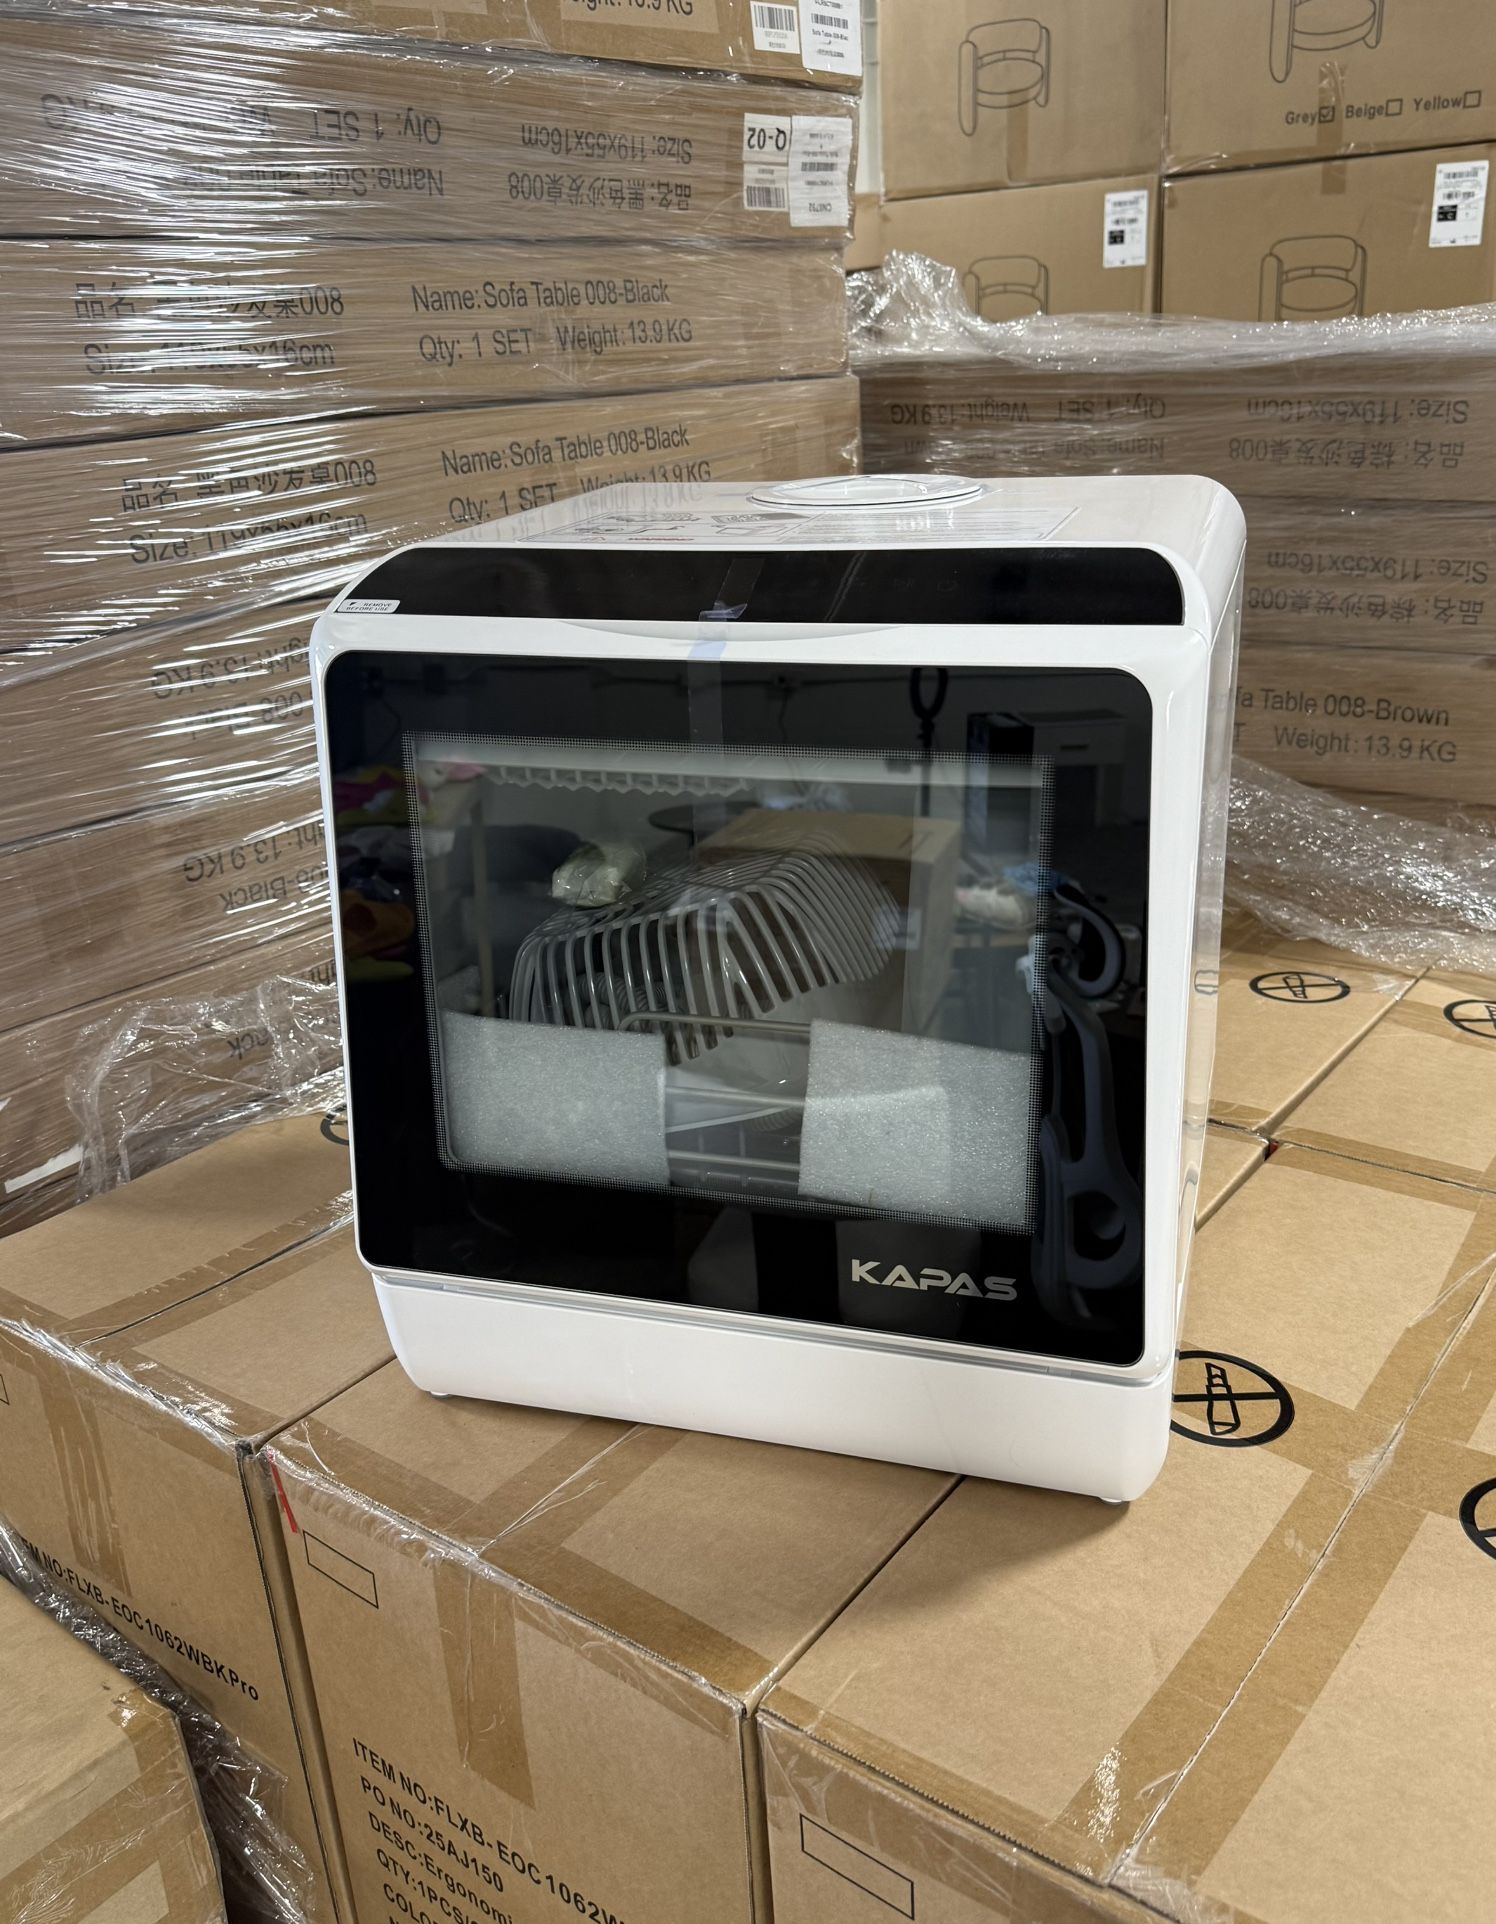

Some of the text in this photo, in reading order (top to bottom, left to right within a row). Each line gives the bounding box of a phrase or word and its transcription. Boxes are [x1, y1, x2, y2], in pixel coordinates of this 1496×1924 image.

[309, 109, 360, 141] SET
[374, 112, 384, 141] 1
[398, 107, 441, 145] Qty:
[1285, 95, 1463, 126] Grey Beige Yellow
[747, 127, 787, 151] Q-02
[530, 281, 582, 307] Table
[585, 279, 670, 305] 008-Black
[419, 334, 463, 367] Qty:
[472, 332, 482, 358] 1
[493, 328, 532, 356] SET
[555, 434, 604, 462] Table
[607, 424, 690, 457] 008-Black
[448, 498, 491, 524] Qty:
[499, 490, 509, 515] 1
[519, 483, 557, 511] SET
[1260, 688, 1318, 713] Table
[1324, 694, 1450, 727] 008-Brown
[851, 1258, 1018, 1301] KAPAS
[352, 1737, 396, 1784] ITEM
[360, 1775, 385, 1806] PO
[383, 1883, 437, 1924] COLO
